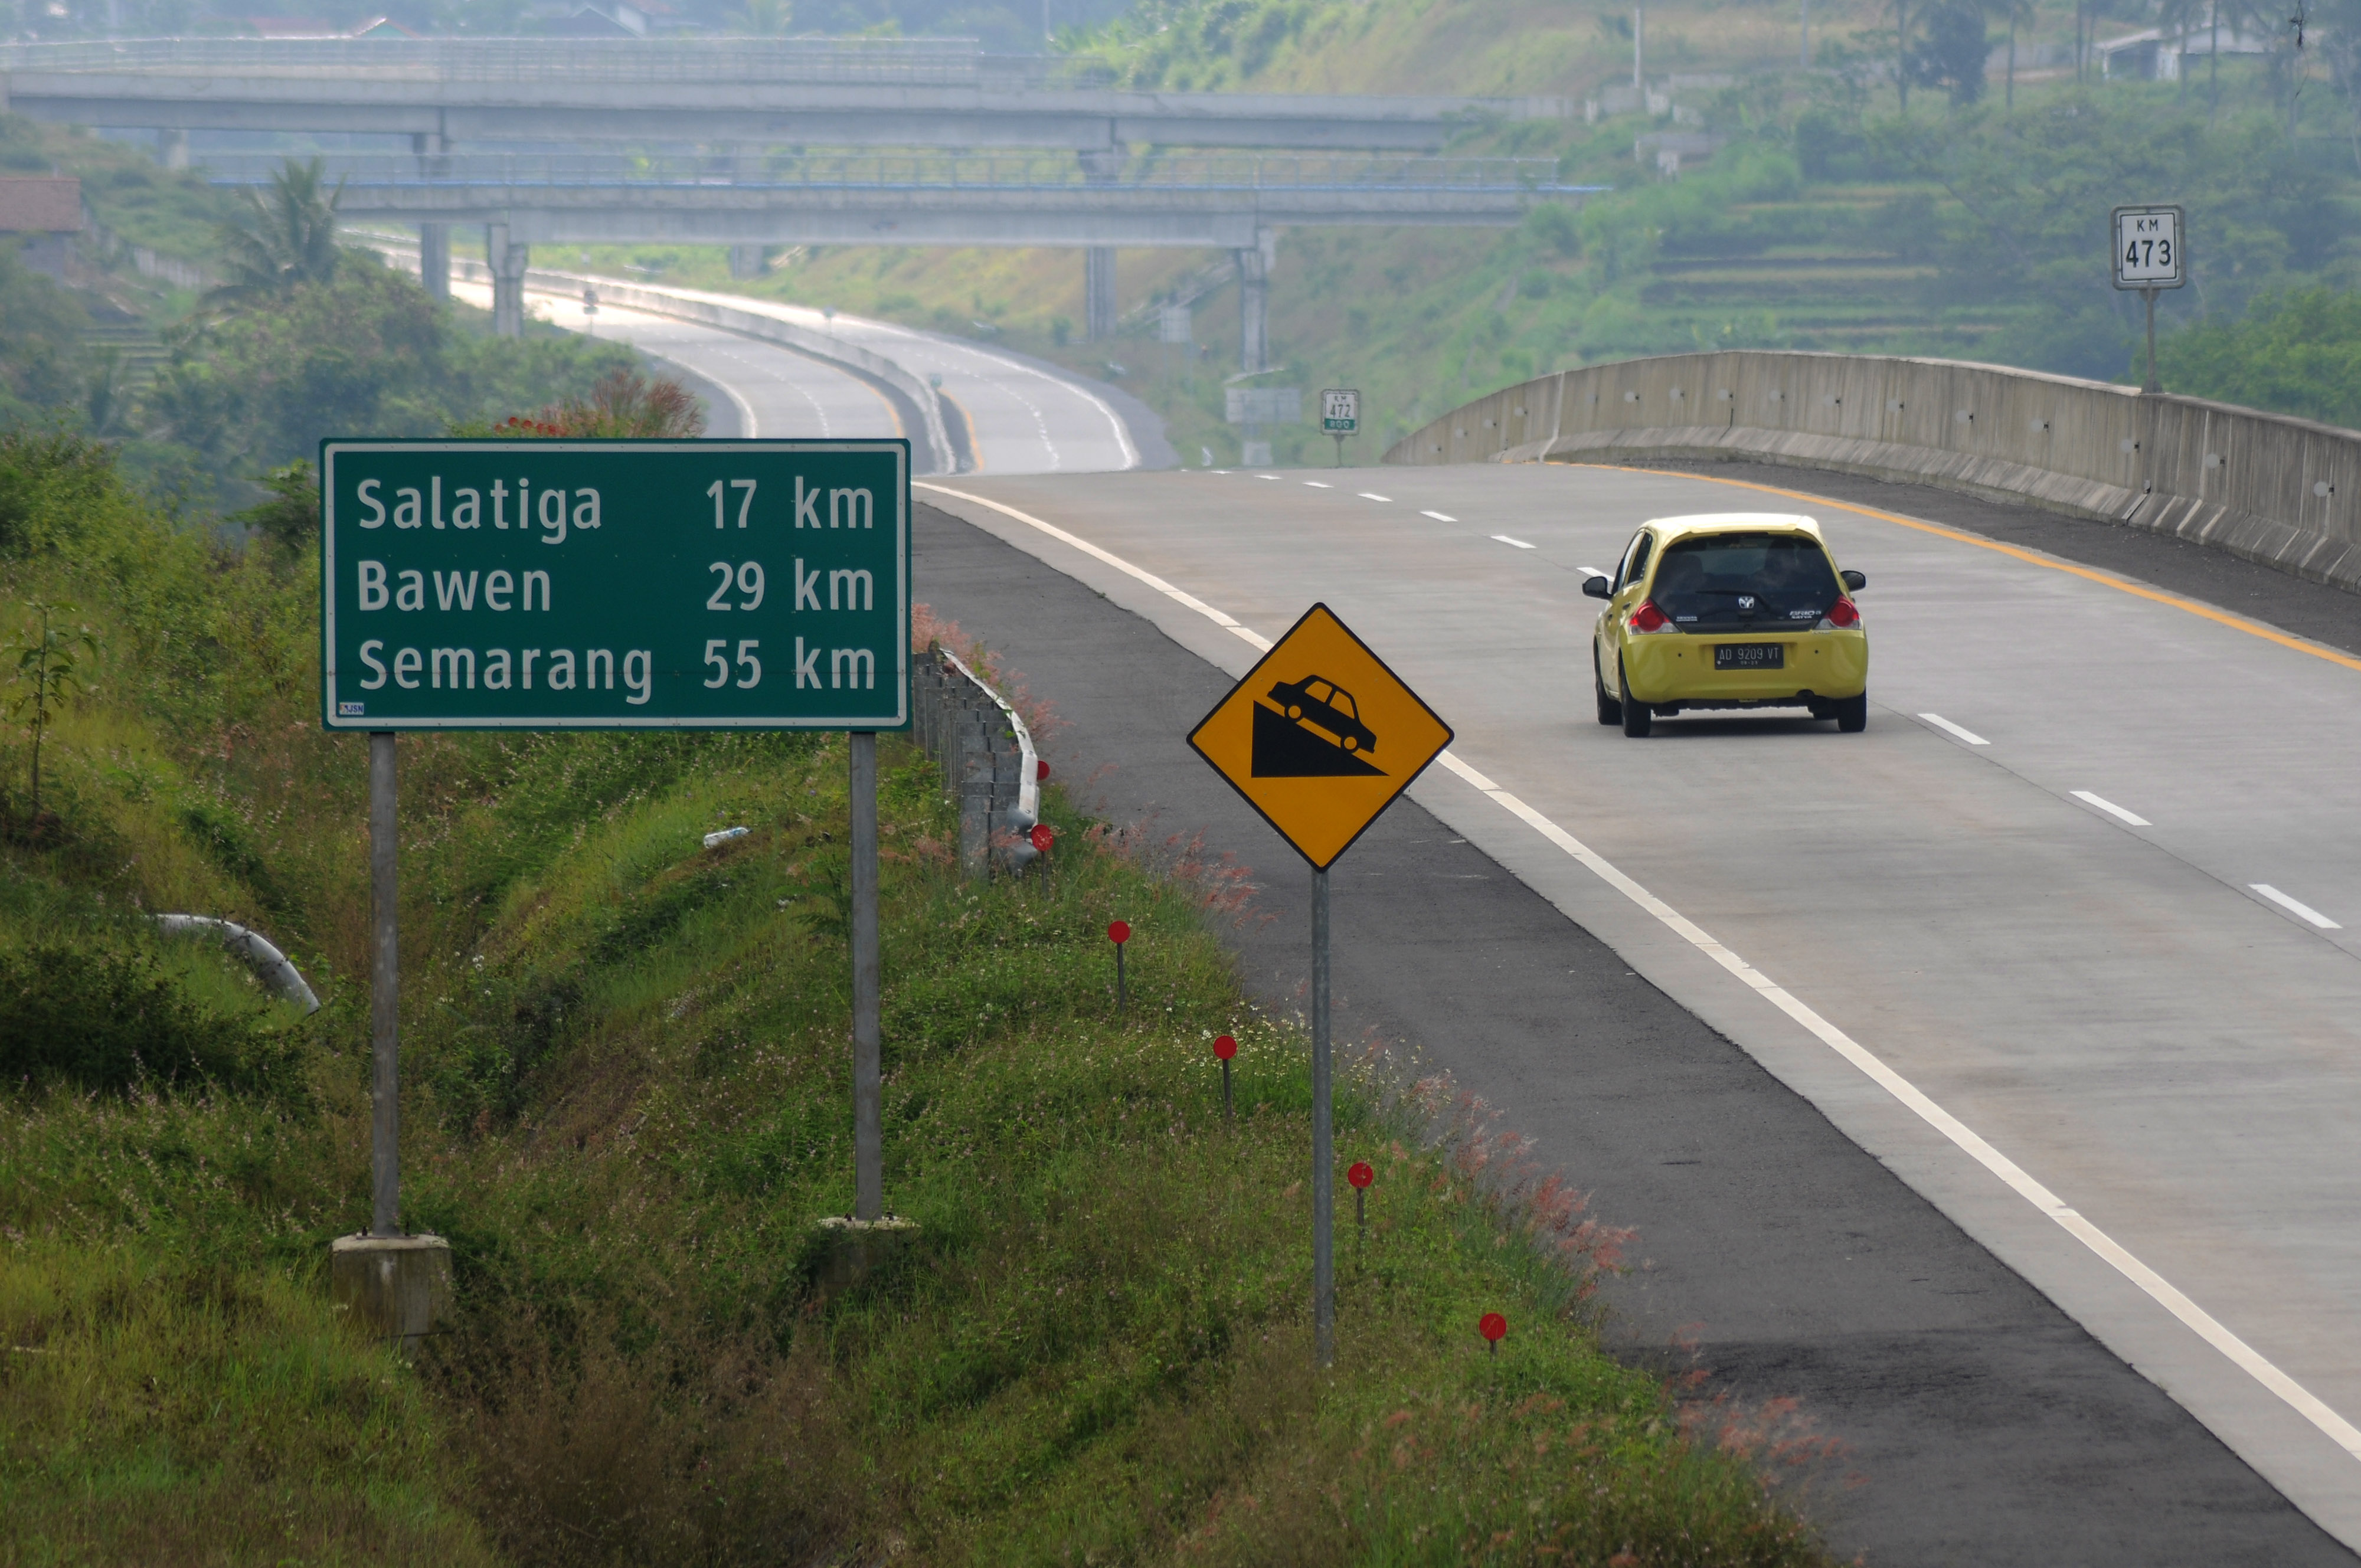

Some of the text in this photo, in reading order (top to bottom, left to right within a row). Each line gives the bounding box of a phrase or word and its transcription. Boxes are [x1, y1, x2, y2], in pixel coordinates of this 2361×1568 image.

[2137, 219, 2159, 232] KM
[2126, 240, 2171, 268] 473
[1330, 404, 1350, 418] 472
[358, 476, 873, 544] Salatiga 17 km
[358, 559, 873, 611] Bawen 29 km
[1719, 647, 1778, 660] AD 9209 VT
[359, 637, 874, 705] Semarang 55 km
